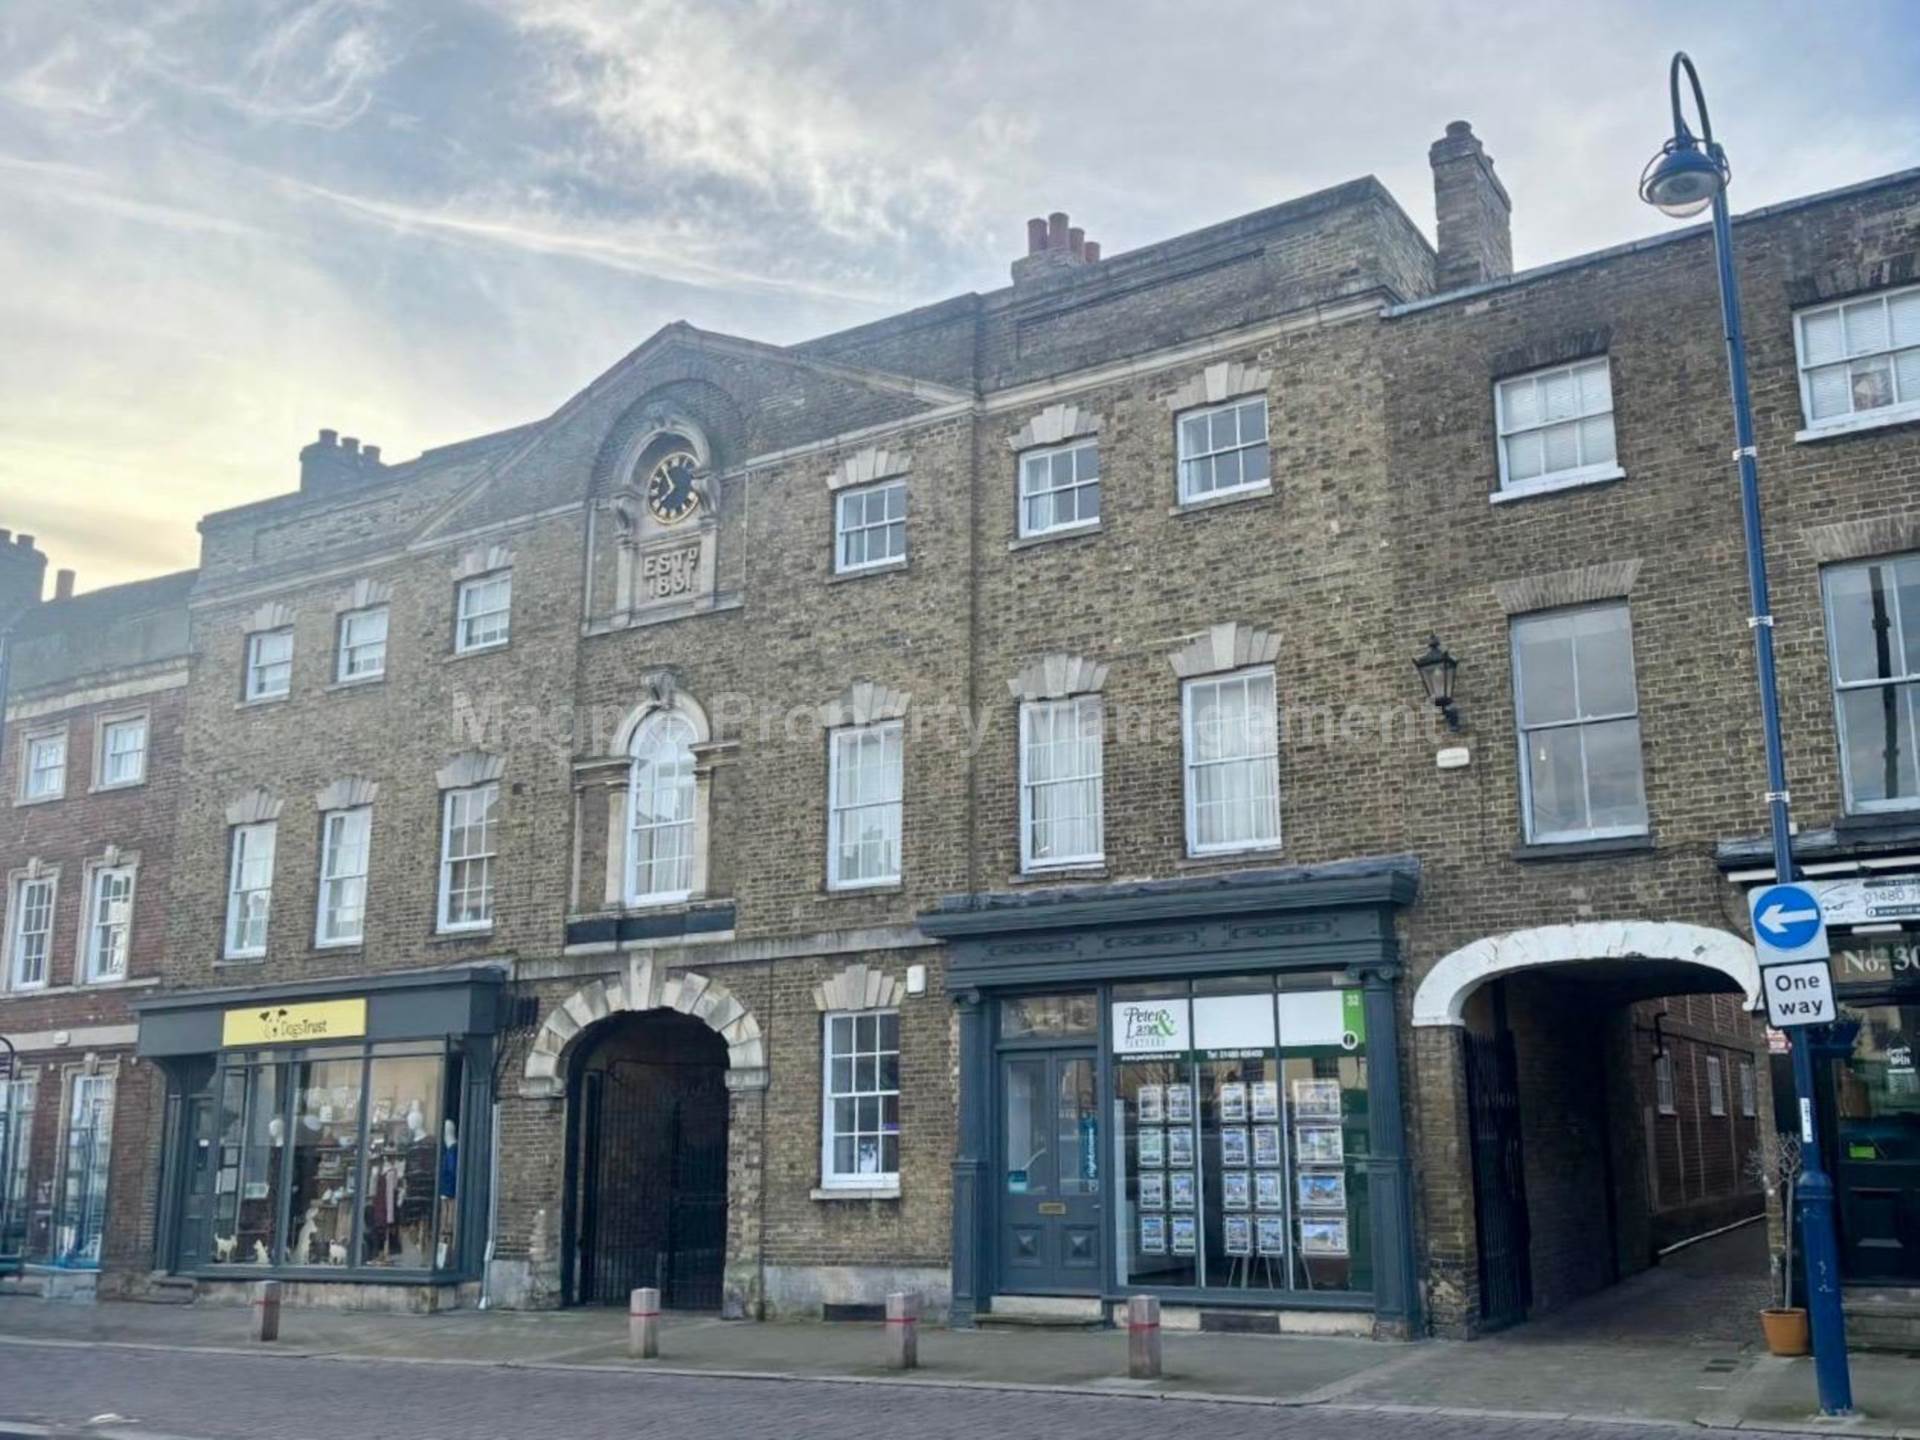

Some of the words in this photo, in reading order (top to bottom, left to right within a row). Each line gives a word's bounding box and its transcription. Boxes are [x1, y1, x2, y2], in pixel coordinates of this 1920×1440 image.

[1843, 951, 1885, 974] No.
[1775, 975, 1820, 992] One
[1778, 1000, 1823, 1017] way
